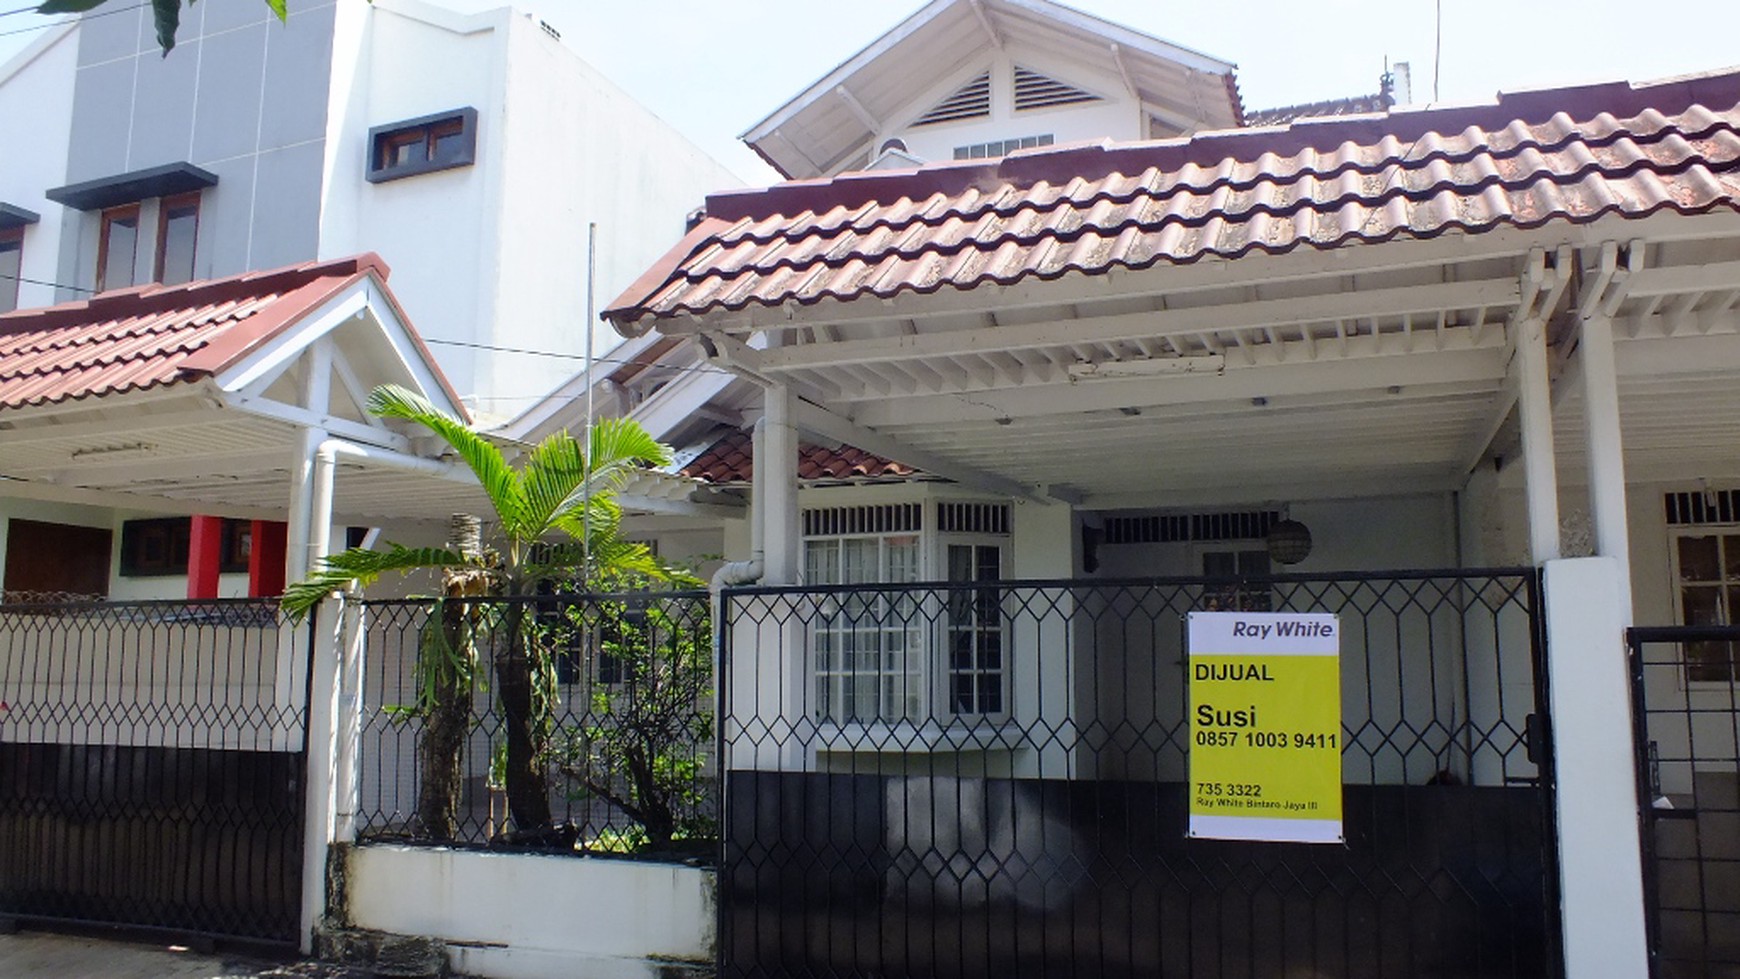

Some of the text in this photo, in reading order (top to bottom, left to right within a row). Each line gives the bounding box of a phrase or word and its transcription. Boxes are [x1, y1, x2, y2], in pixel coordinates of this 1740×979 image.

[1233, 621, 1333, 639] Ray White
[1195, 664, 1275, 681] DIJUAL
[1197, 704, 1256, 727] Susi
[1196, 731, 1336, 749] 0857 1003 9411
[1197, 783, 1262, 797] 735 3322
[1196, 797, 1214, 808] Ray
[1216, 798, 1243, 808] White
[1247, 800, 1281, 809] Bintaro
[1284, 801, 1306, 811] Jaya
